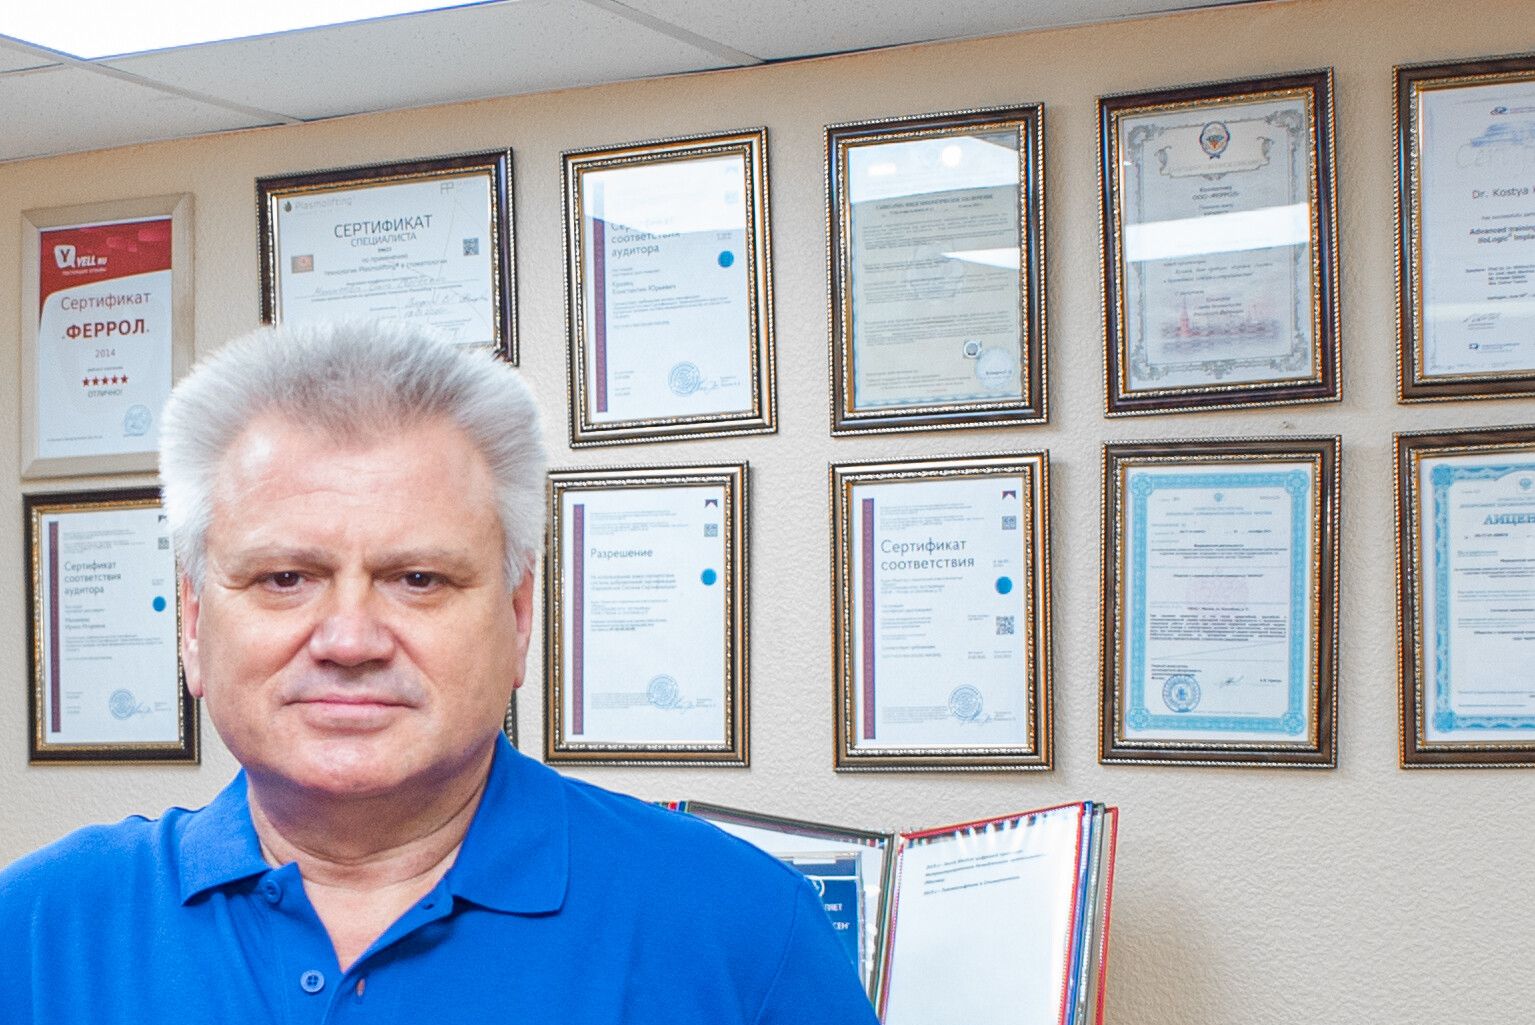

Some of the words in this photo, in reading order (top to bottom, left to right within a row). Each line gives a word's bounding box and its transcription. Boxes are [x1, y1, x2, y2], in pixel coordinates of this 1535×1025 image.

[334, 214, 433, 239] СЕРТИФИКАТ
[351, 232, 417, 247] СПЕЦИАЛИСТА
[61, 291, 152, 313] Сертификат
[881, 537, 967, 556] Сертификат
[590, 548, 654, 560] Разрешение
[65, 560, 117, 572] Сертификат
[881, 557, 975, 571] соответствия
[65, 573, 122, 583] соответствия
[65, 586, 105, 596] аудитора
